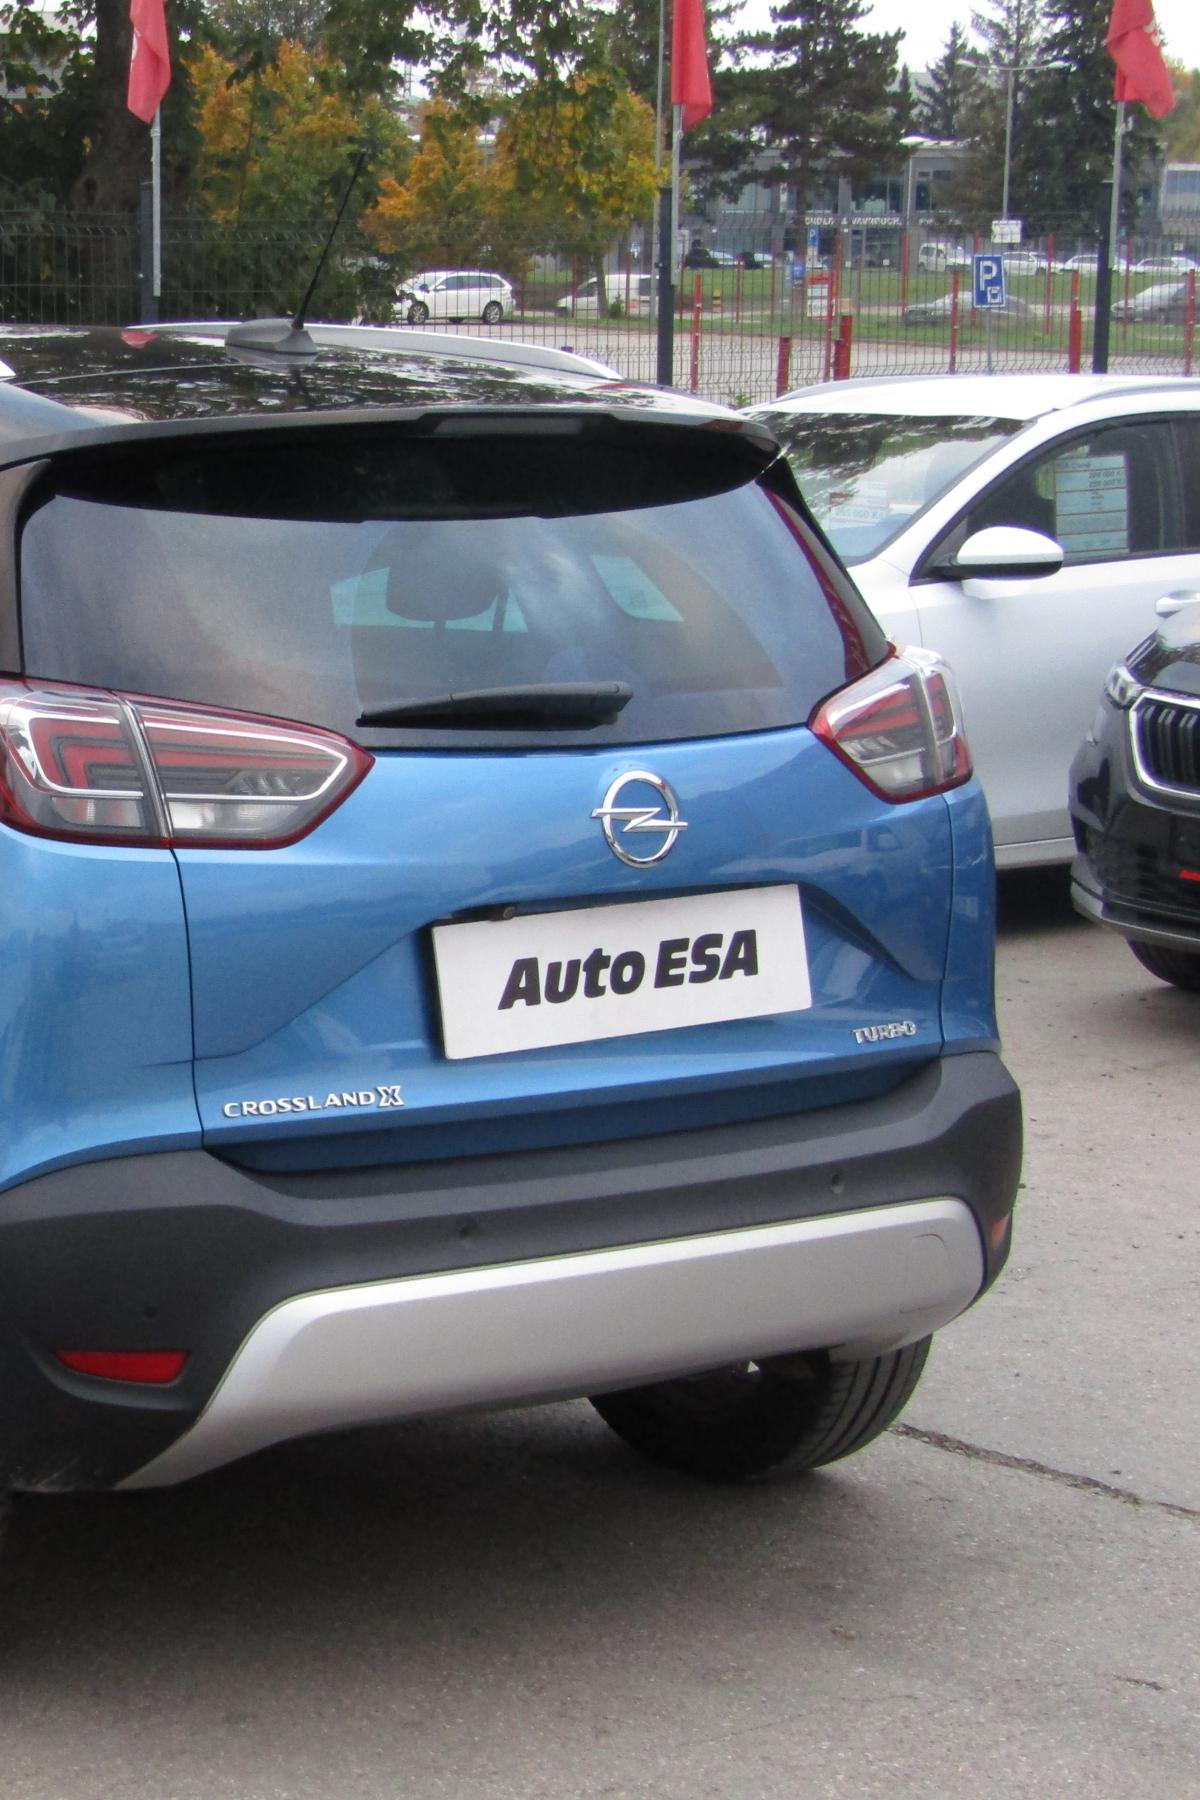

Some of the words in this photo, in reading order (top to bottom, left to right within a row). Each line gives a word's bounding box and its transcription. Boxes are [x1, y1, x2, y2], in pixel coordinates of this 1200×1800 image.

[979, 260, 998, 291] P
[497, 947, 646, 1011] Auto
[653, 928, 759, 989] ESA
[852, 1020, 917, 1044] TURBO
